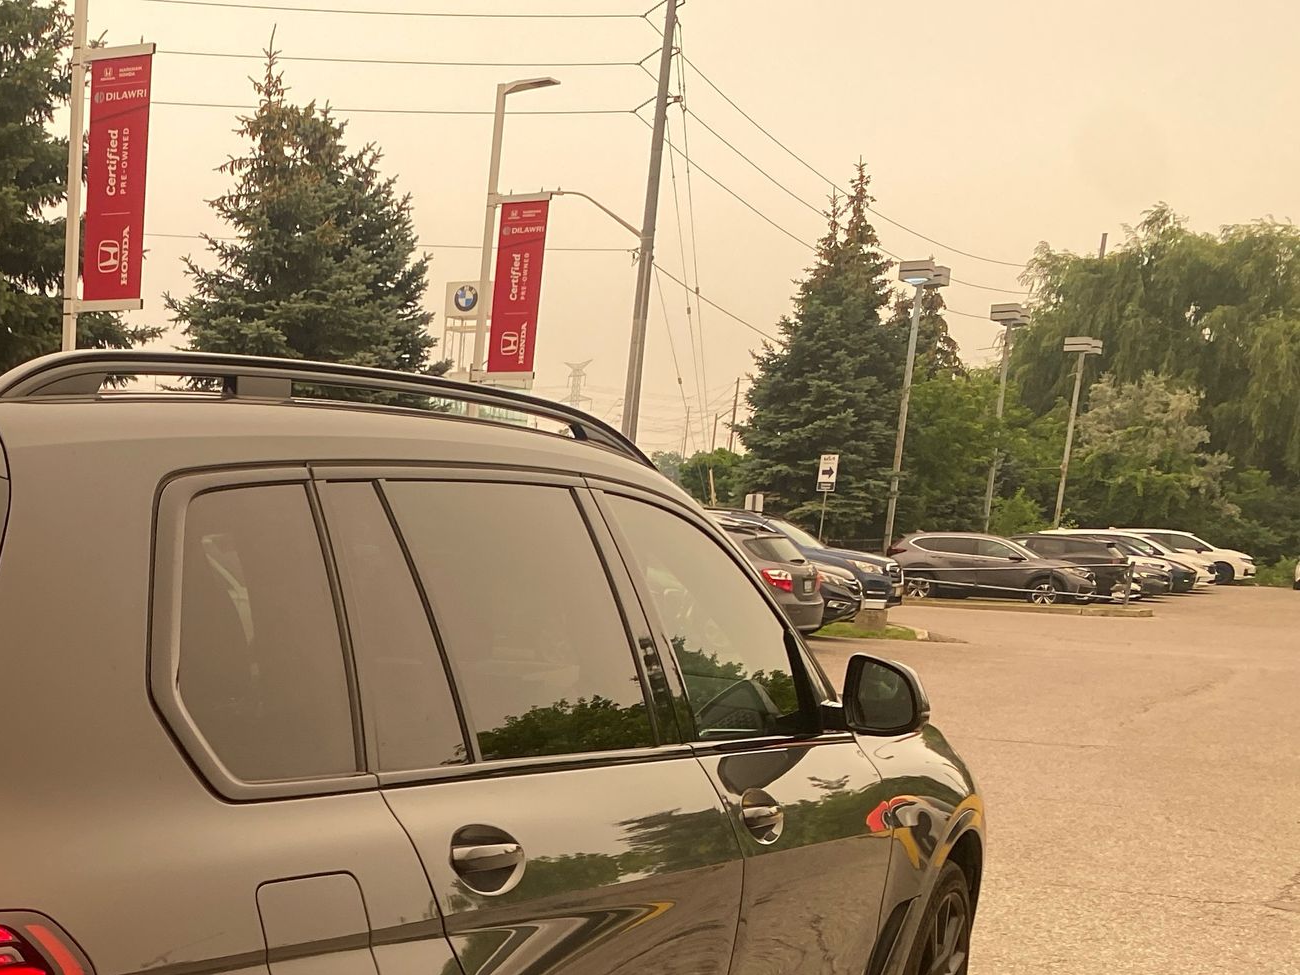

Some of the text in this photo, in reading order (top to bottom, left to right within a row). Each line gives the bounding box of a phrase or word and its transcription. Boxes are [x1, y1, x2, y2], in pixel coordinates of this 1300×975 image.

[105, 89, 147, 102] DILAWRI
[106, 129, 120, 196] Certified
[120, 127, 130, 195] PRE-OWNED
[511, 226, 544, 234] DILAWRI
[121, 225, 131, 286] HONDA
[509, 253, 521, 301] Certified
[518, 321, 528, 365] HONDA
